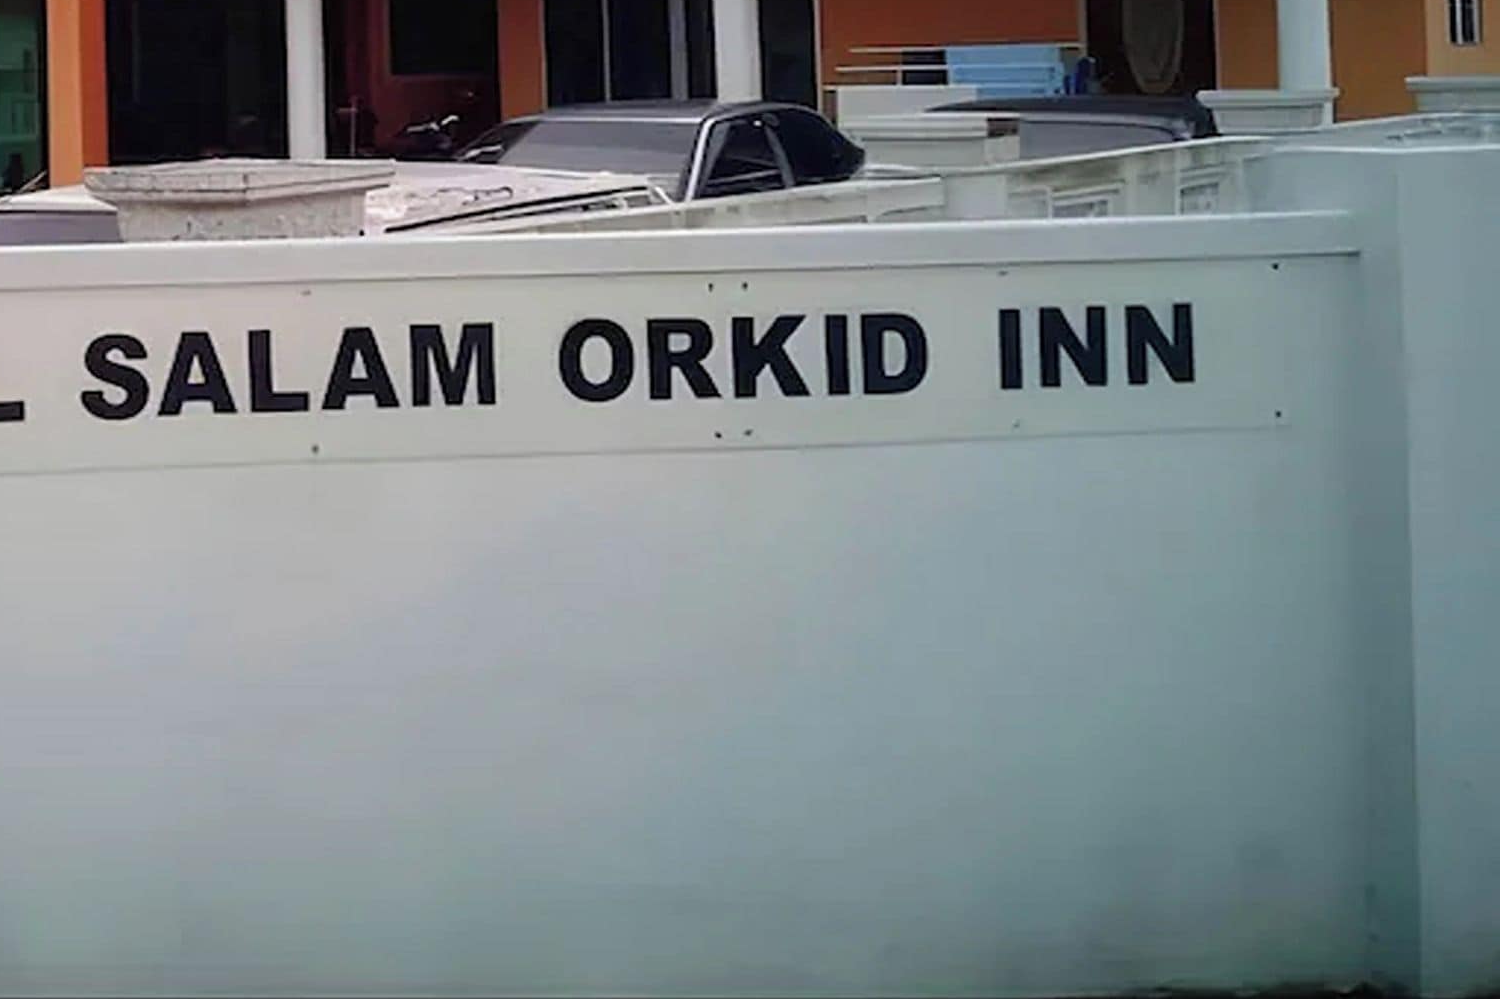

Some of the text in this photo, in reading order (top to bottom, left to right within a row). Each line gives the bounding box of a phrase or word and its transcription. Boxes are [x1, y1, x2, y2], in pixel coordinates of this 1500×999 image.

[81, 323, 497, 421] SALAM
[558, 314, 928, 401] ORKID
[998, 303, 1196, 390] INN
